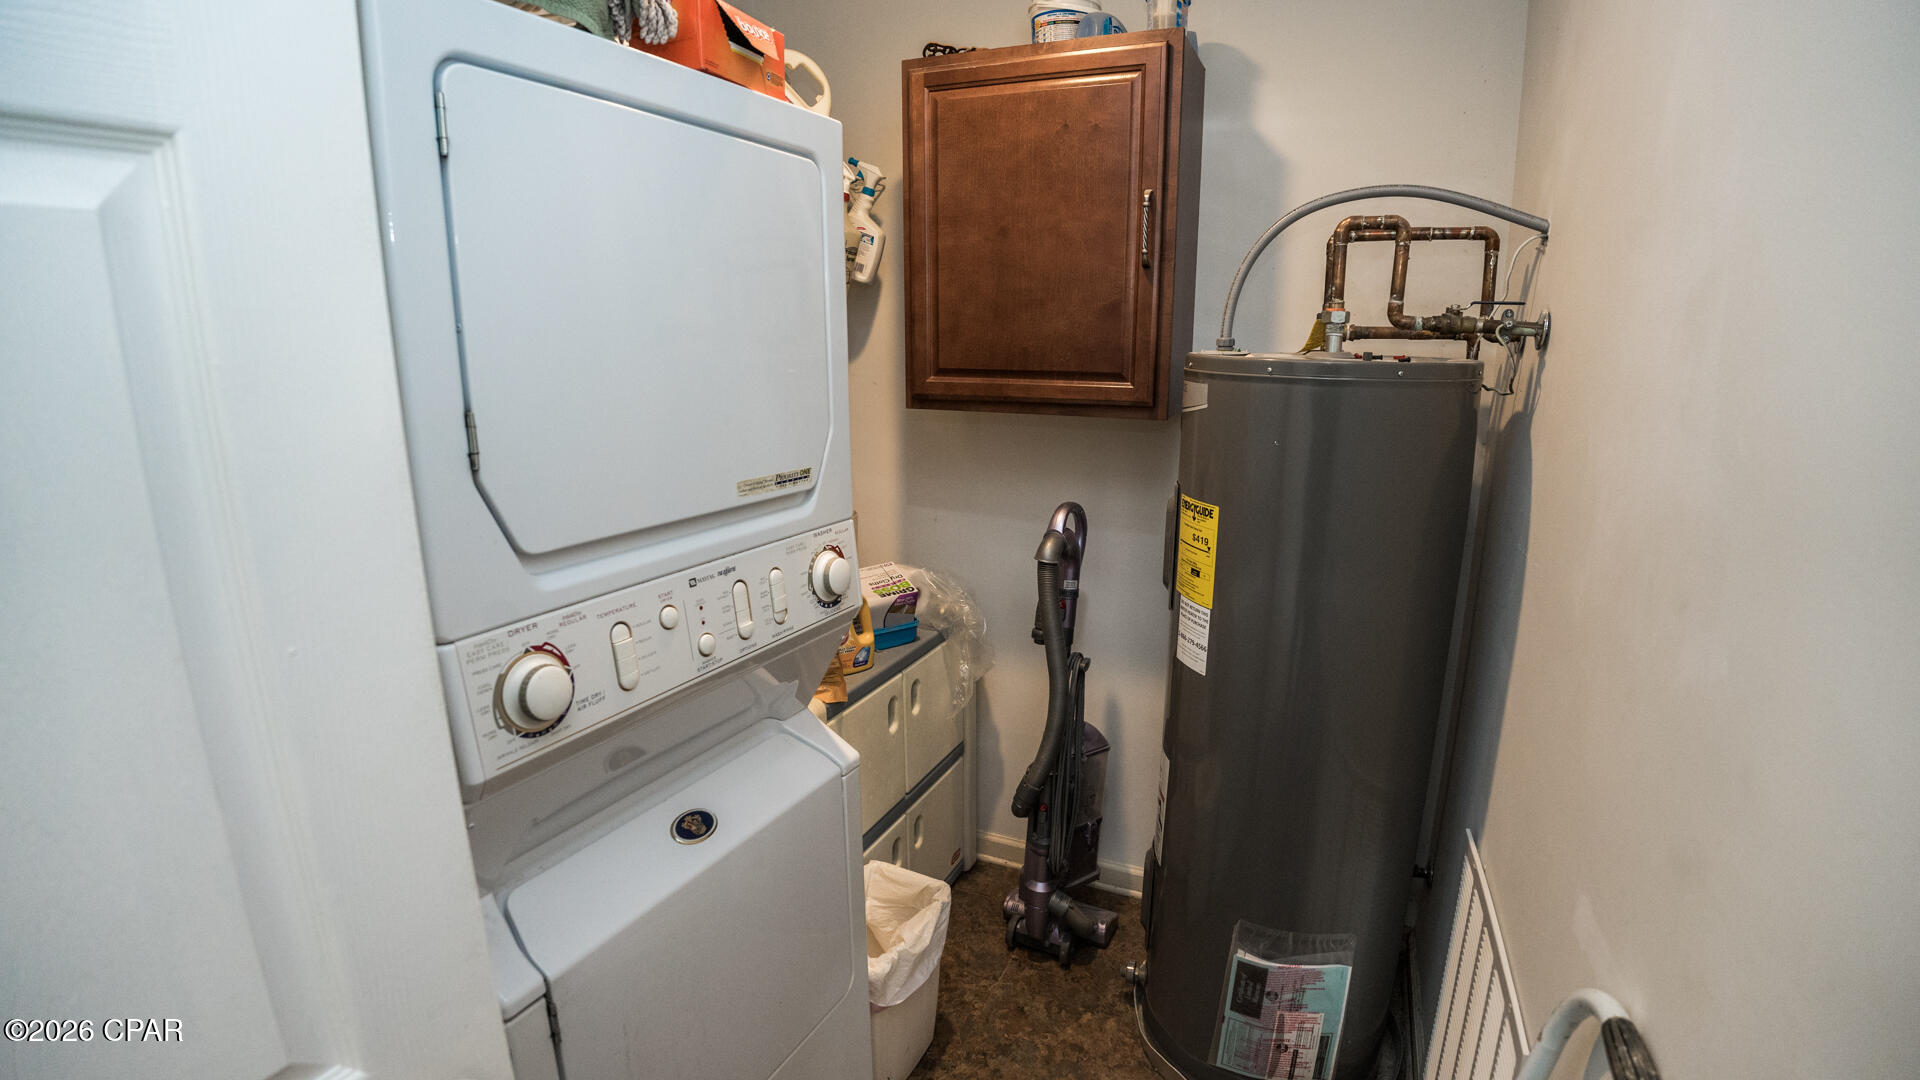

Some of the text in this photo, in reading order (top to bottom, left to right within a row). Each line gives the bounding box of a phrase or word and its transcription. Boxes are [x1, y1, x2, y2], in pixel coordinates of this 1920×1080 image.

[1191, 533, 1209, 546] $419
[596, 602, 638, 620] TEMPERATURE
[507, 622, 538, 638] DRYER
[1191, 619, 1207, 630] PURCHASE
[576, 697, 590, 707] TIME
[590, 692, 602, 702] DRY
[577, 696, 606, 712] AIR FLUFF
